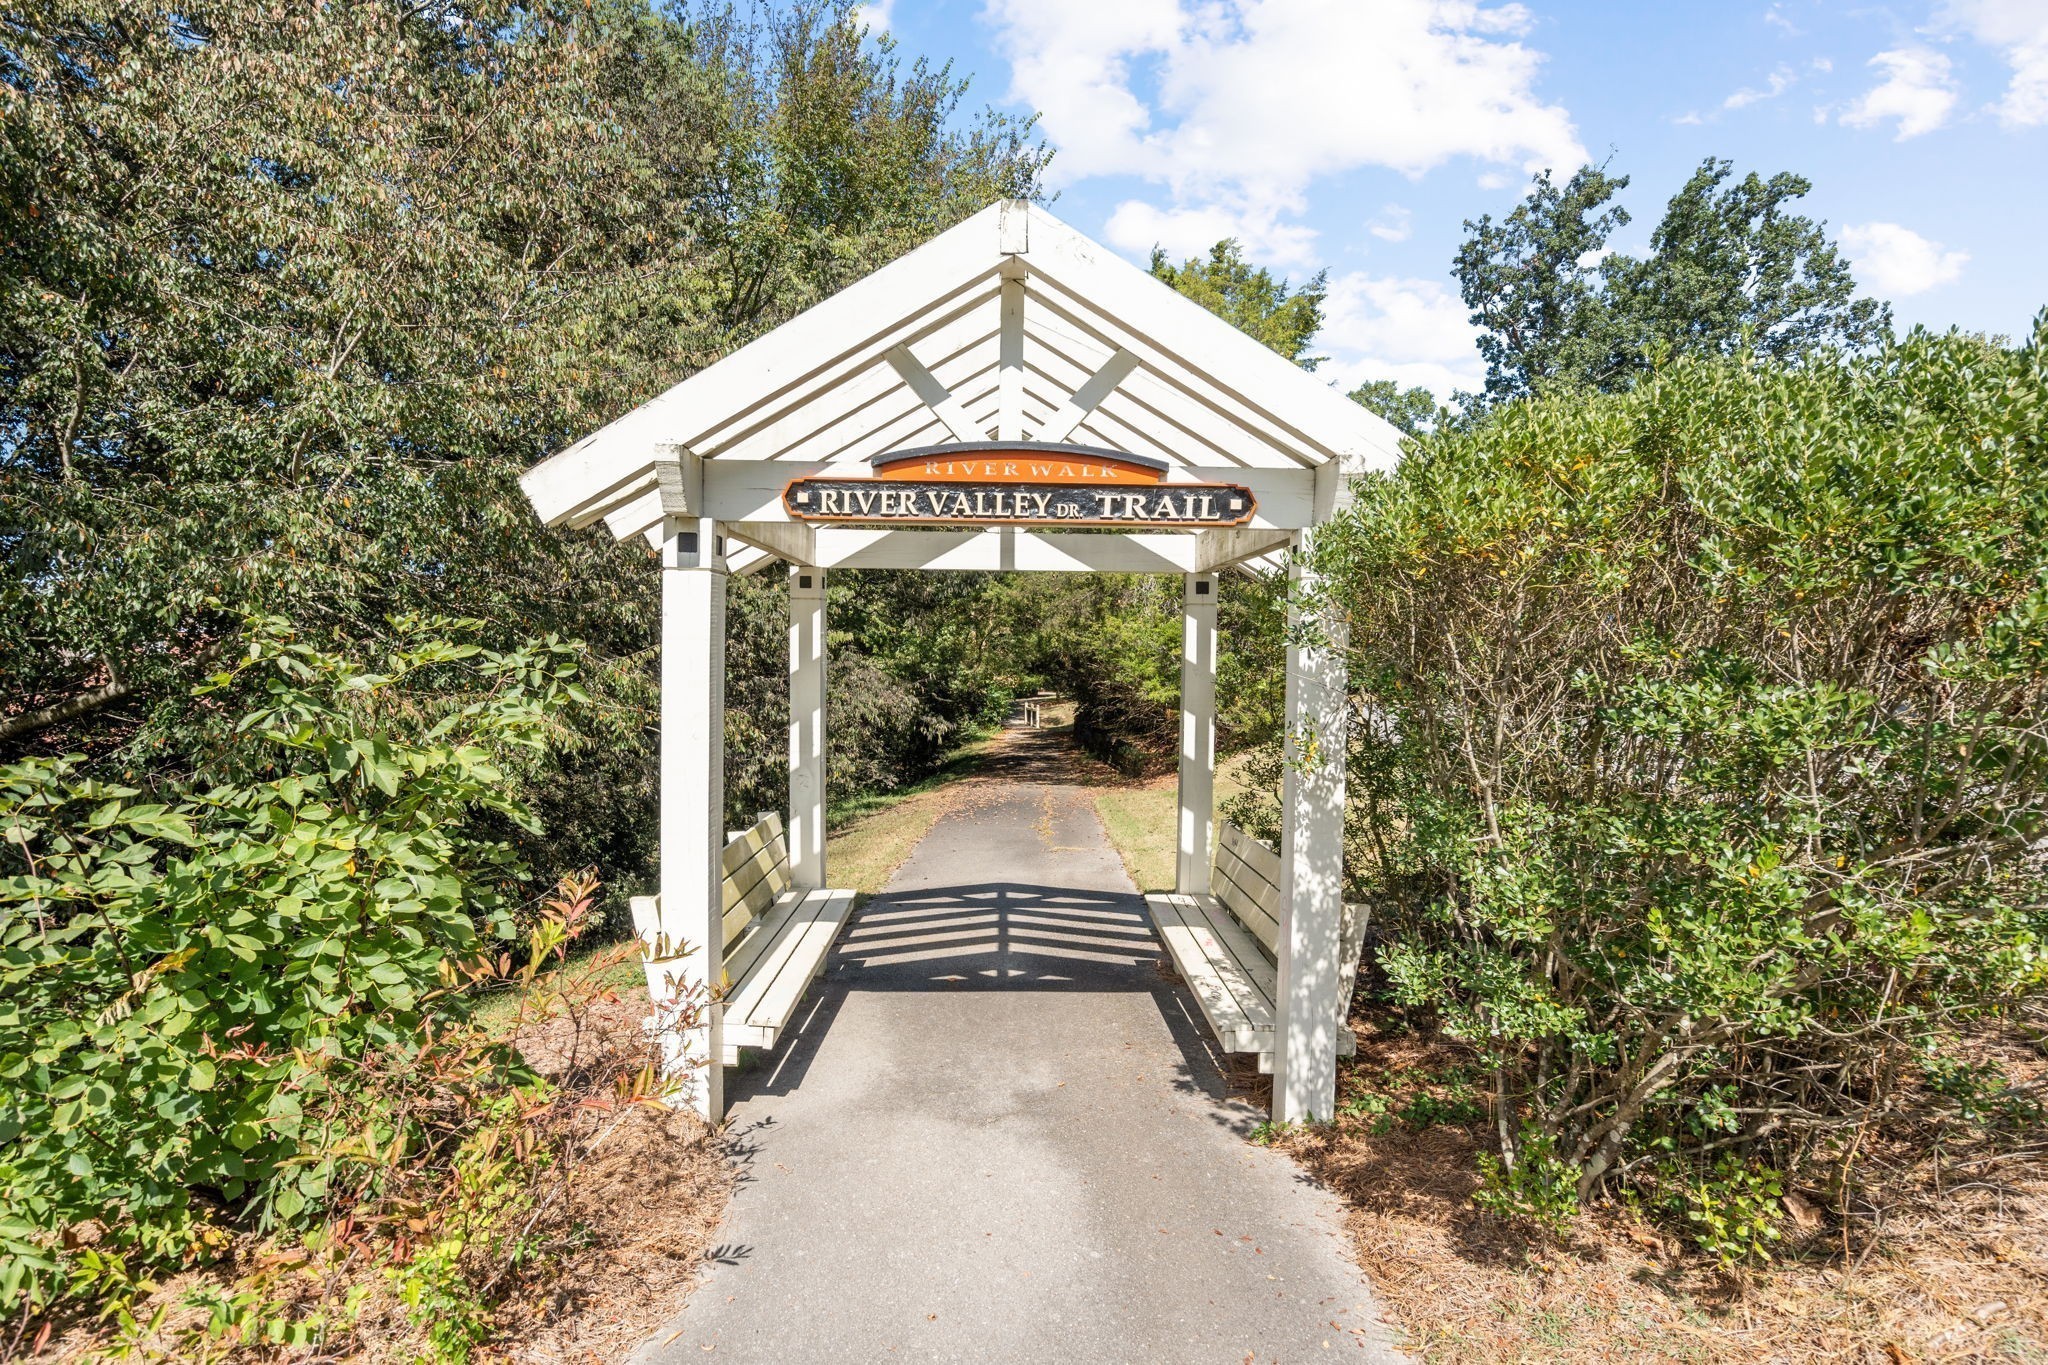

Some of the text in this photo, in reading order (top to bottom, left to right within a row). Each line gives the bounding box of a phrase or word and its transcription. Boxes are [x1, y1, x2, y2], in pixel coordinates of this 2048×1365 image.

[924, 461, 1119, 478] RIVER WALK
[819, 489, 1221, 520] RIVER VALLEY DR. TRAIL
